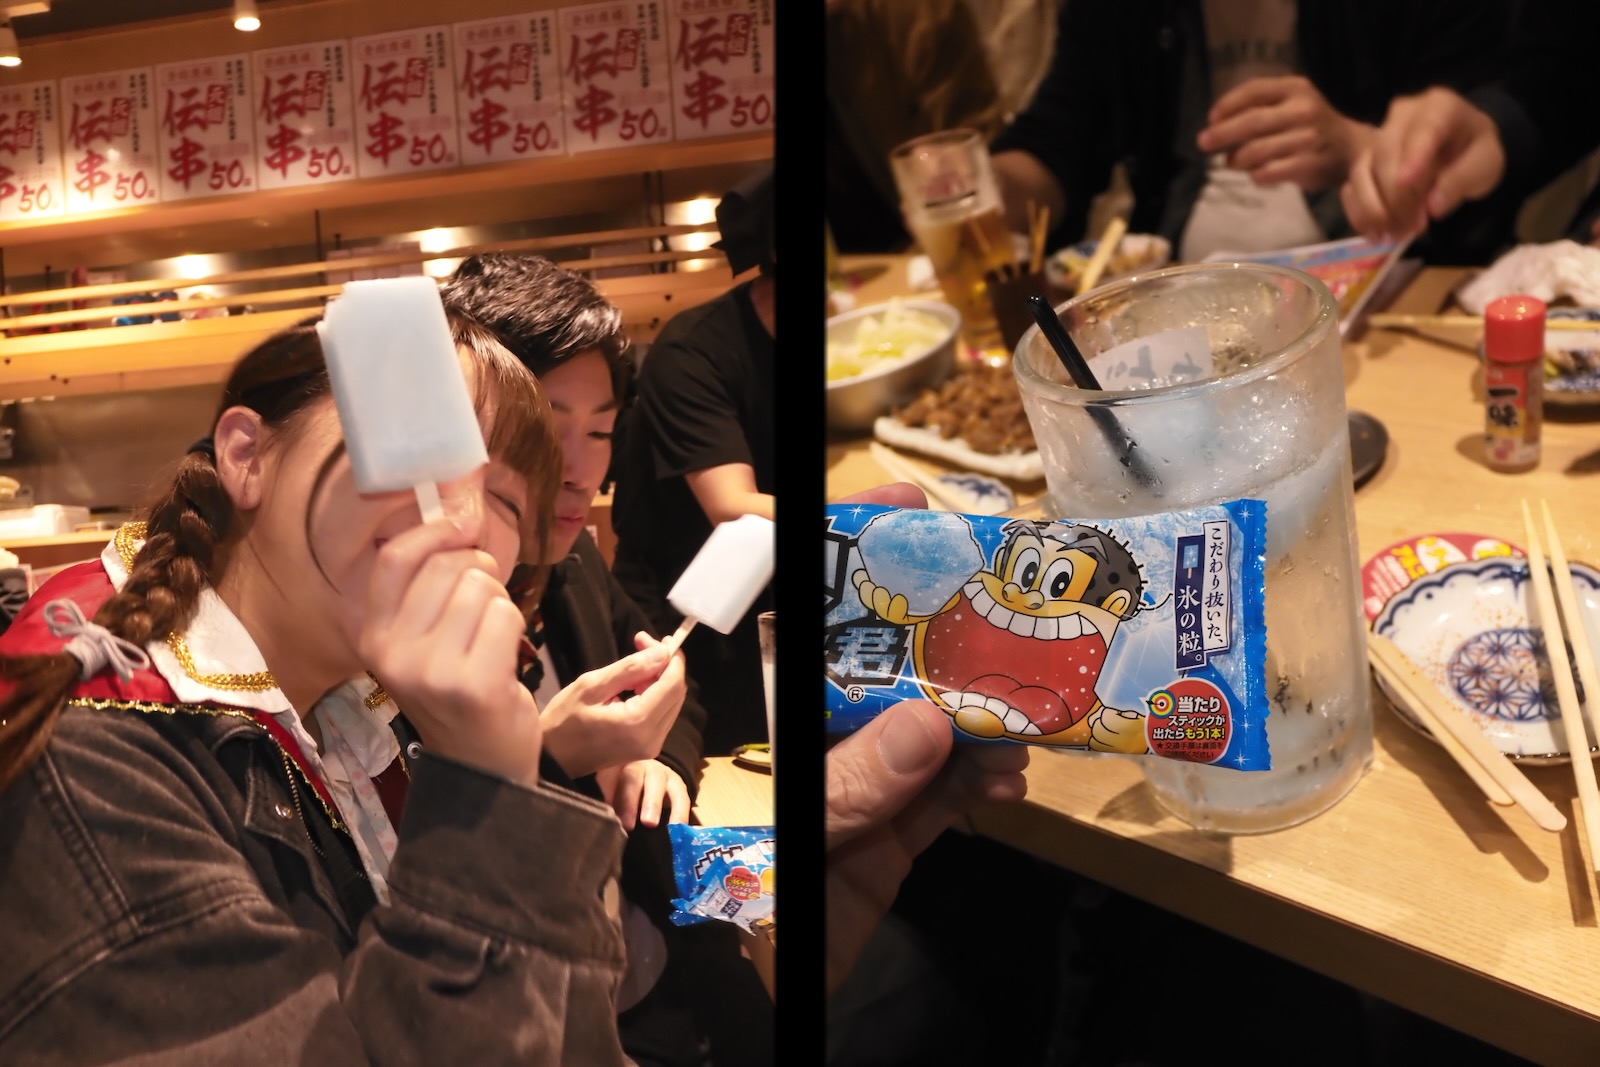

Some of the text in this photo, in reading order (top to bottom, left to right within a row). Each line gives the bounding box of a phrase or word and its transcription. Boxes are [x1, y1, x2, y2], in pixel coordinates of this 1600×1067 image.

[1205, 528, 1225, 644] こだわり抜いた、
[1176, 585, 1202, 662] 氷の粒。
[1167, 715, 1225, 727] スティックが
[1177, 696, 1221, 713] 当たり
